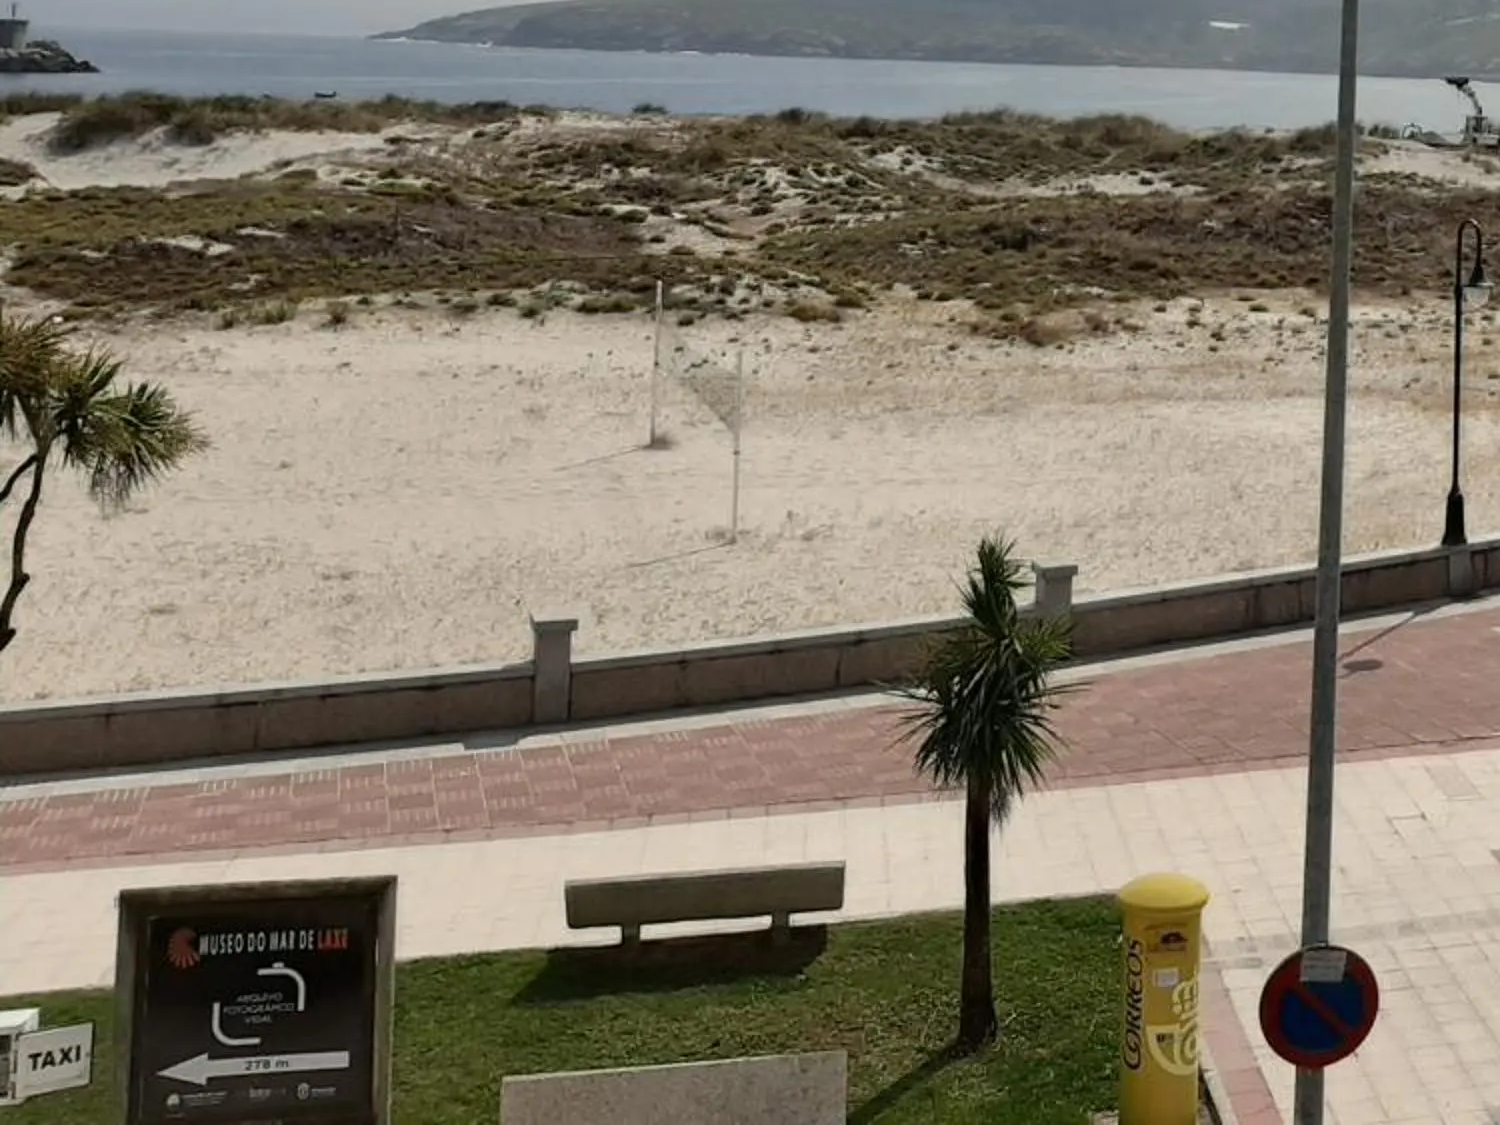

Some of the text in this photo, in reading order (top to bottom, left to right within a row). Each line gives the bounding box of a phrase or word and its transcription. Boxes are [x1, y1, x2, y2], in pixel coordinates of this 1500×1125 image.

[199, 931, 245, 956] MUSEO
[247, 931, 267, 953] DO
[269, 929, 296, 951] MAR
[299, 929, 315, 950] DE
[1123, 938, 1143, 1071] CORREOS
[28, 1045, 81, 1071] TAXI
